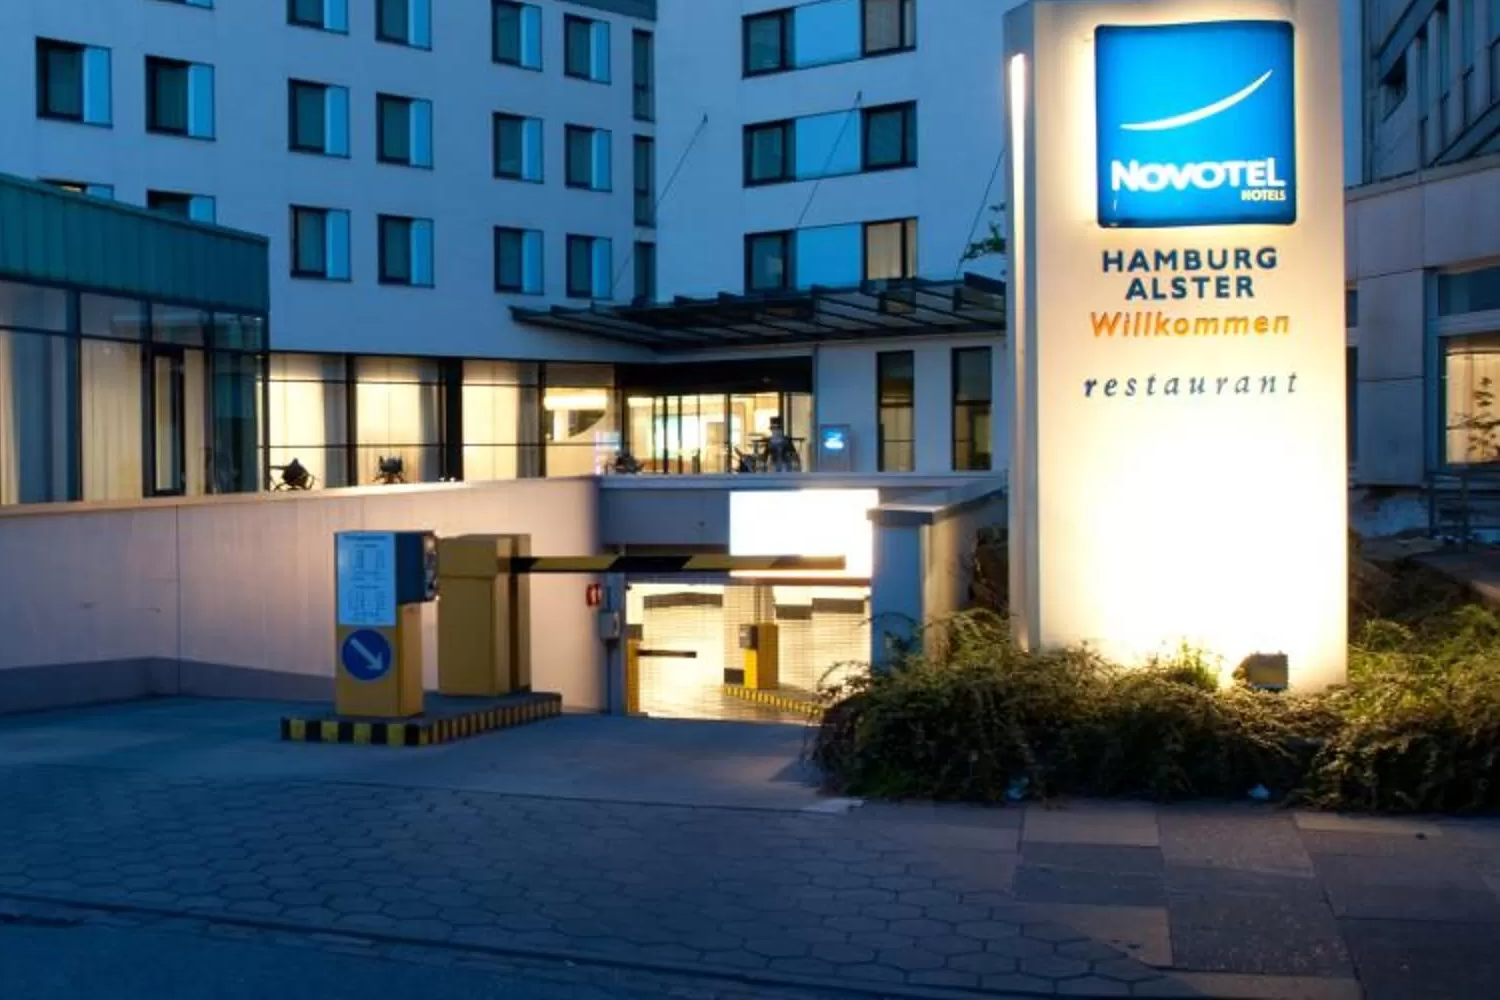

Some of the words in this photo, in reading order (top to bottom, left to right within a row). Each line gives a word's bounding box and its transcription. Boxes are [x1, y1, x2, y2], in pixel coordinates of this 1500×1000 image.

[1111, 158, 1286, 192] NOVOTEL
[1241, 189, 1286, 201] HOTELS
[1102, 247, 1278, 273] HAMBURG
[1125, 275, 1255, 300] ALSTER
[1090, 311, 1291, 338] Willkommen
[1084, 371, 1298, 398] restaurant
